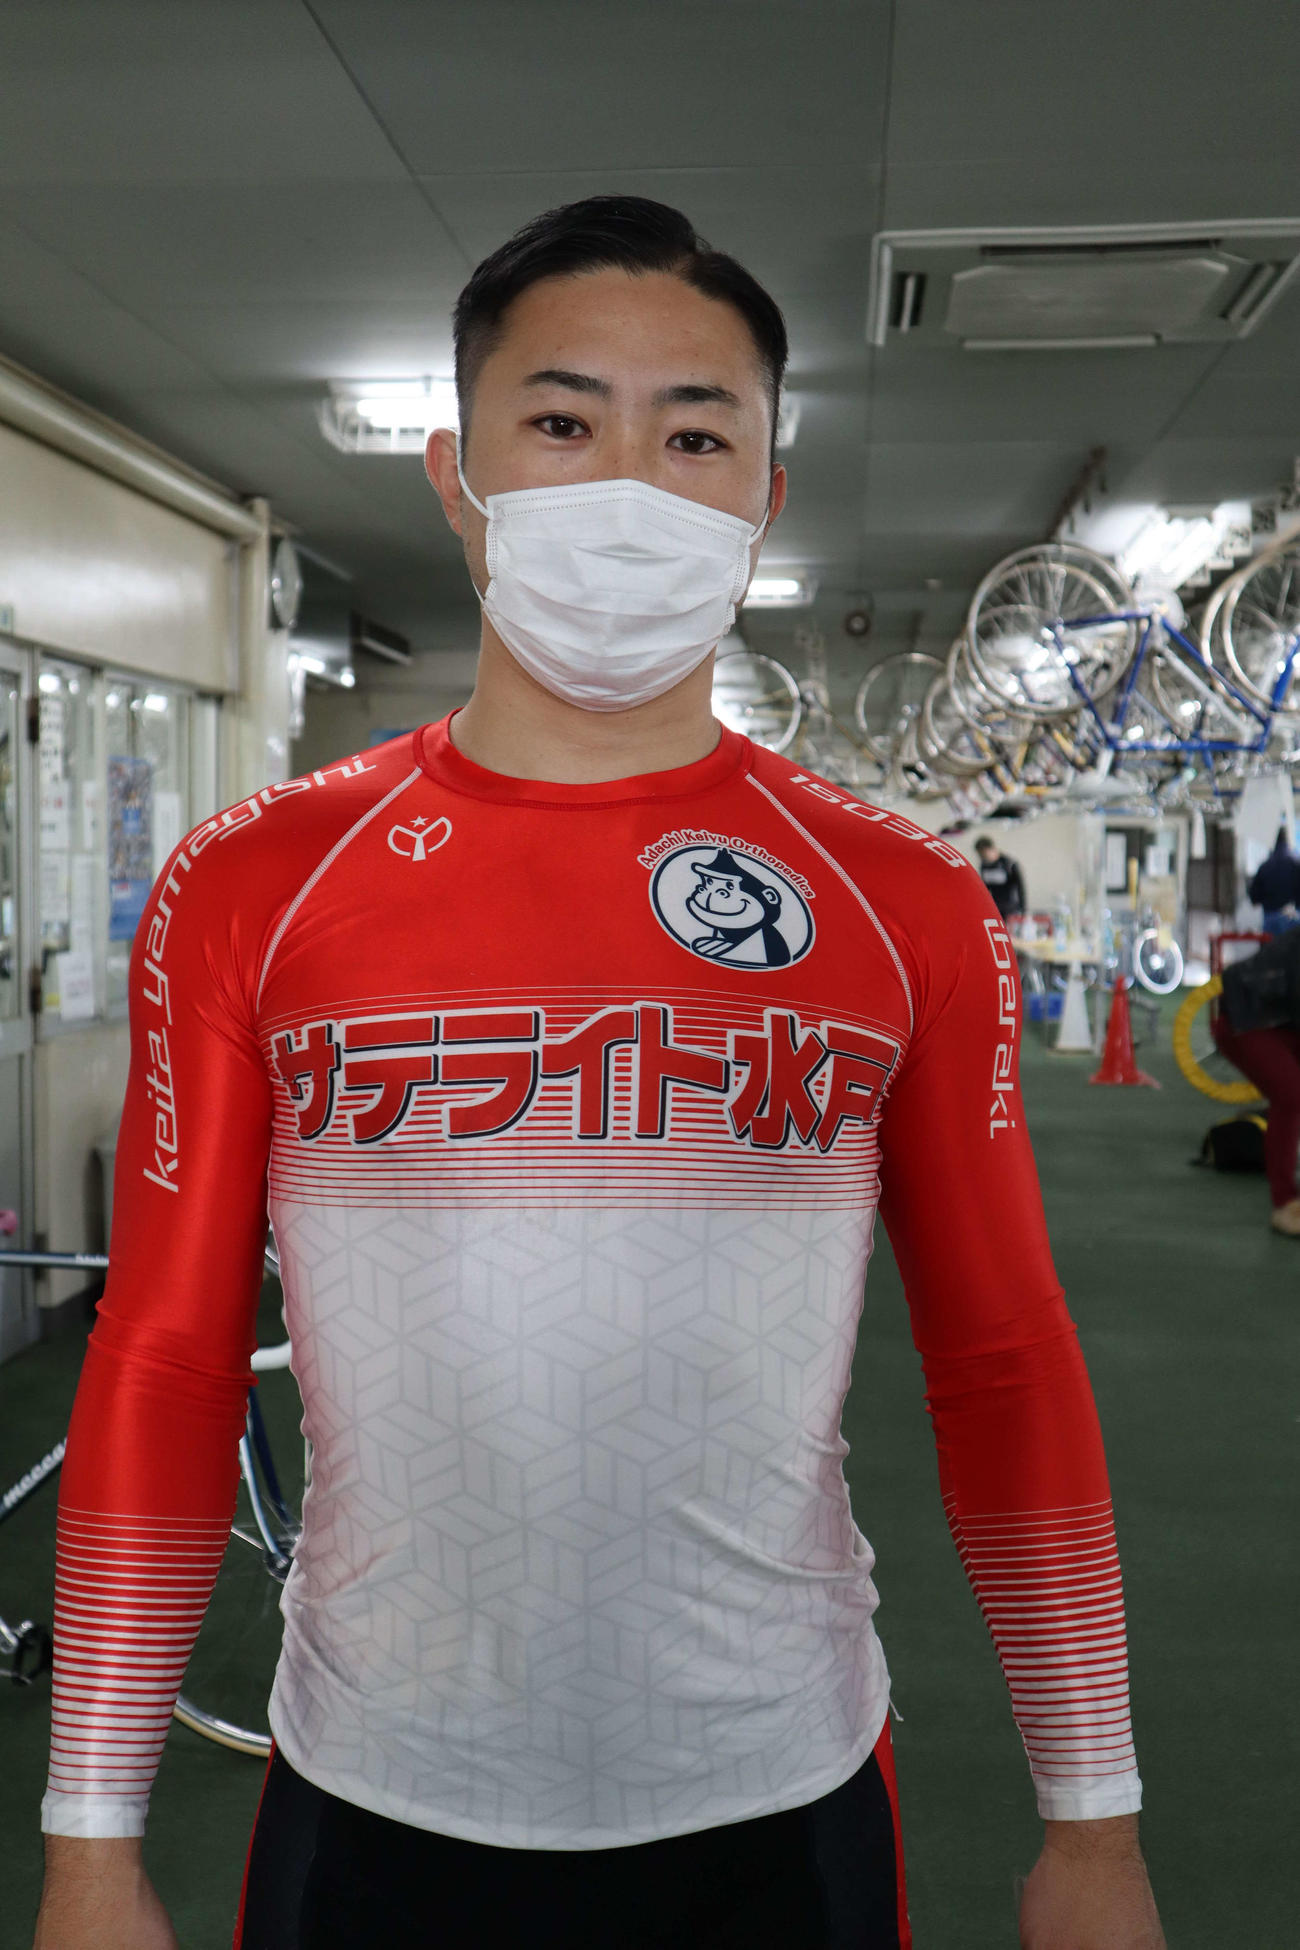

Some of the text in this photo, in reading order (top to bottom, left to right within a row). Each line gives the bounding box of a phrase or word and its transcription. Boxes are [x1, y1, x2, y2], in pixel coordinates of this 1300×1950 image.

[638, 829, 816, 899] Adachi Keiyu Orthopedics
[789, 773, 968, 868] 15038
[273, 1001, 900, 1154] サテライト水戸
[983, 918, 1017, 1140] ibaraki
[143, 1027, 178, 1193] keita
